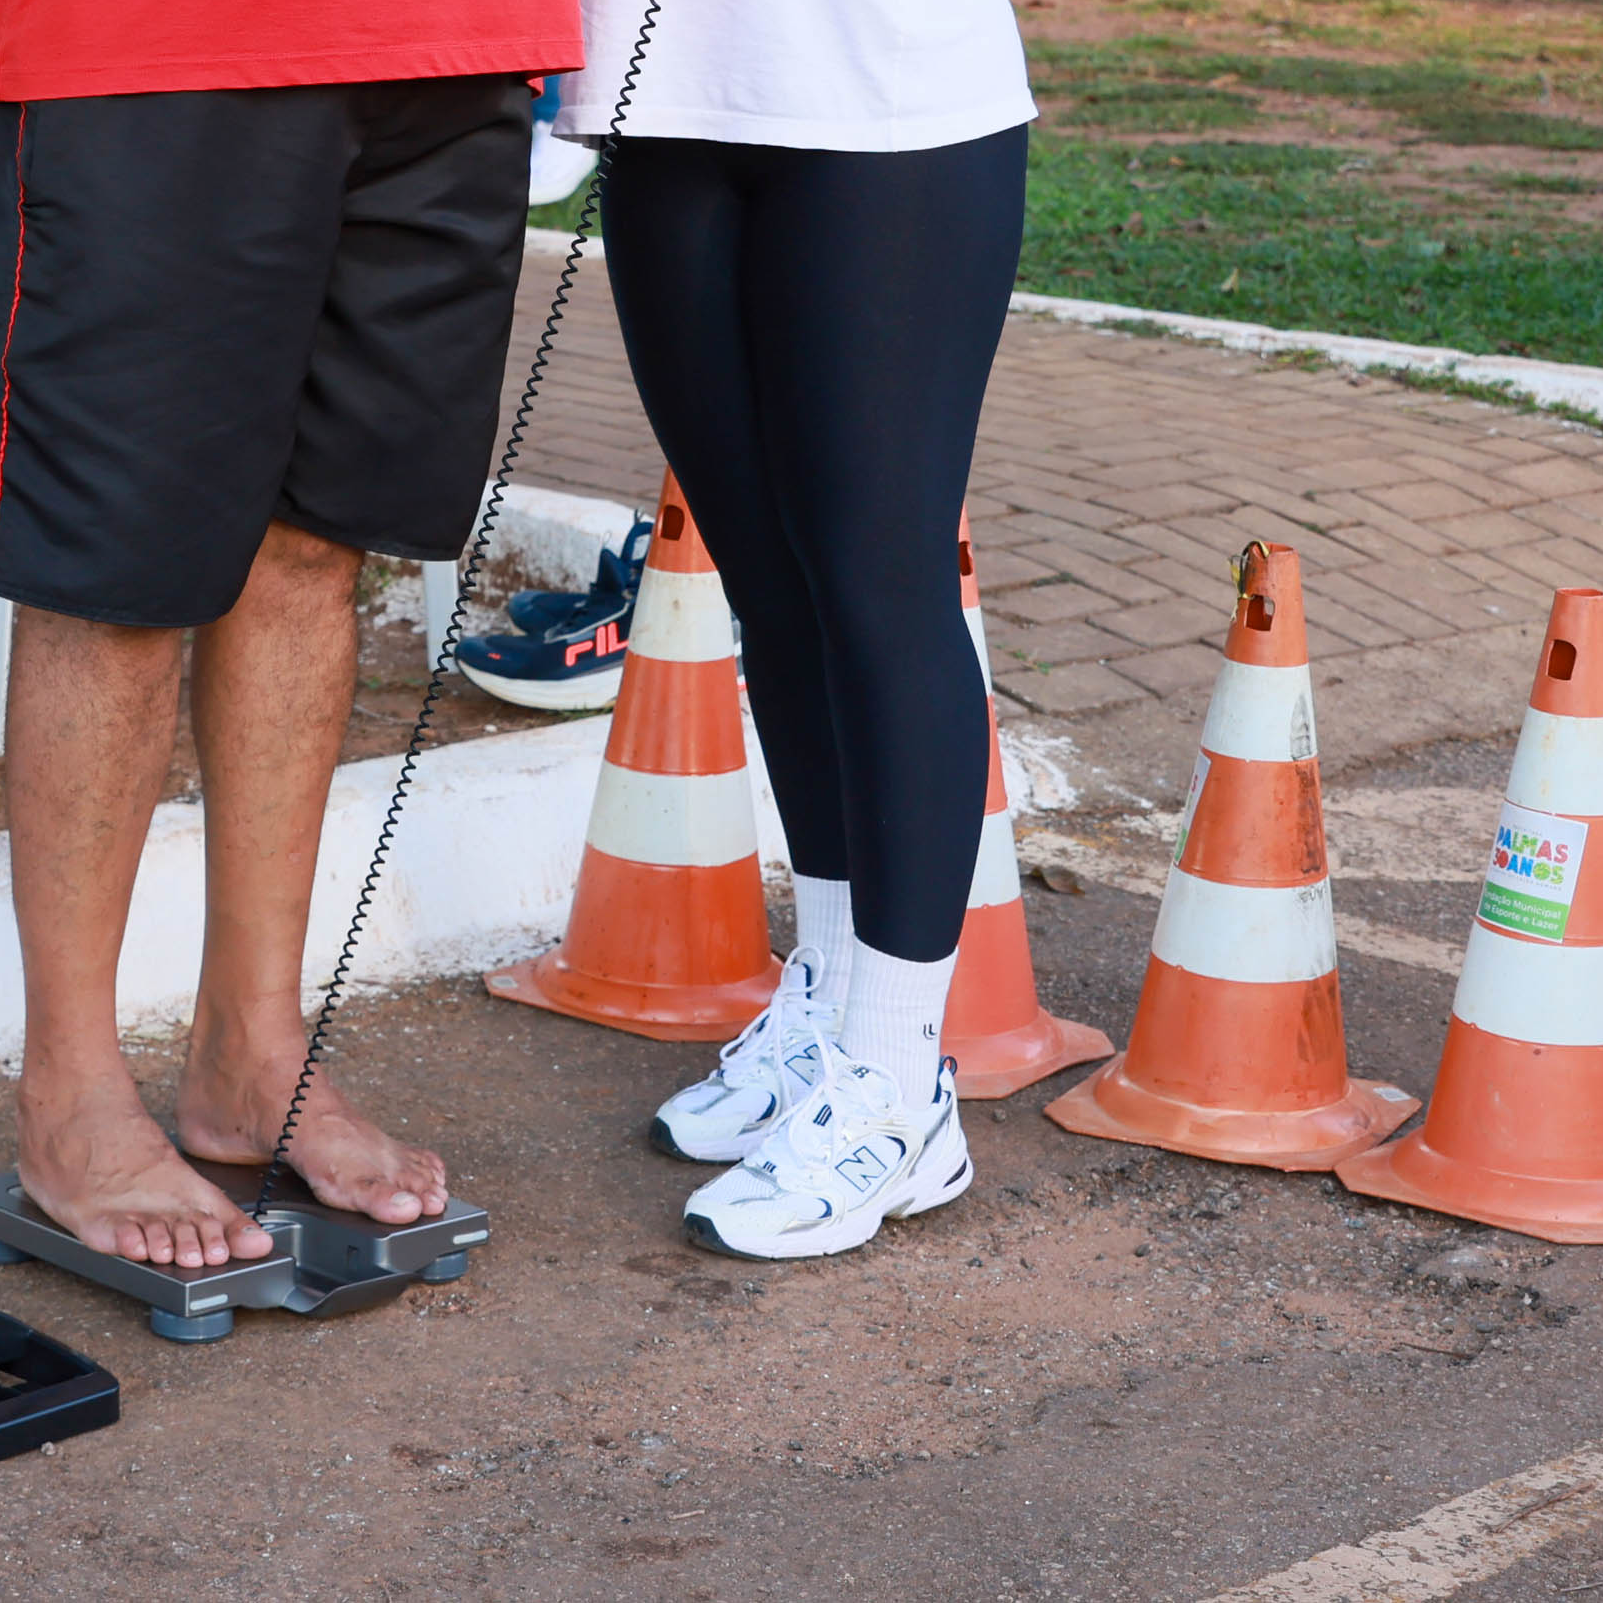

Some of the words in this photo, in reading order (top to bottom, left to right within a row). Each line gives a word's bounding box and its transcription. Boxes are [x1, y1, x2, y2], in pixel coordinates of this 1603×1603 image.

[565, 622, 629, 667] FIL
[1496, 825, 1569, 864] PALMAS
[1491, 904, 1522, 922] Esporte
[1531, 915, 1560, 931] Lazer
[1512, 898, 1562, 920] Municipal
[835, 1144, 888, 1194] N
